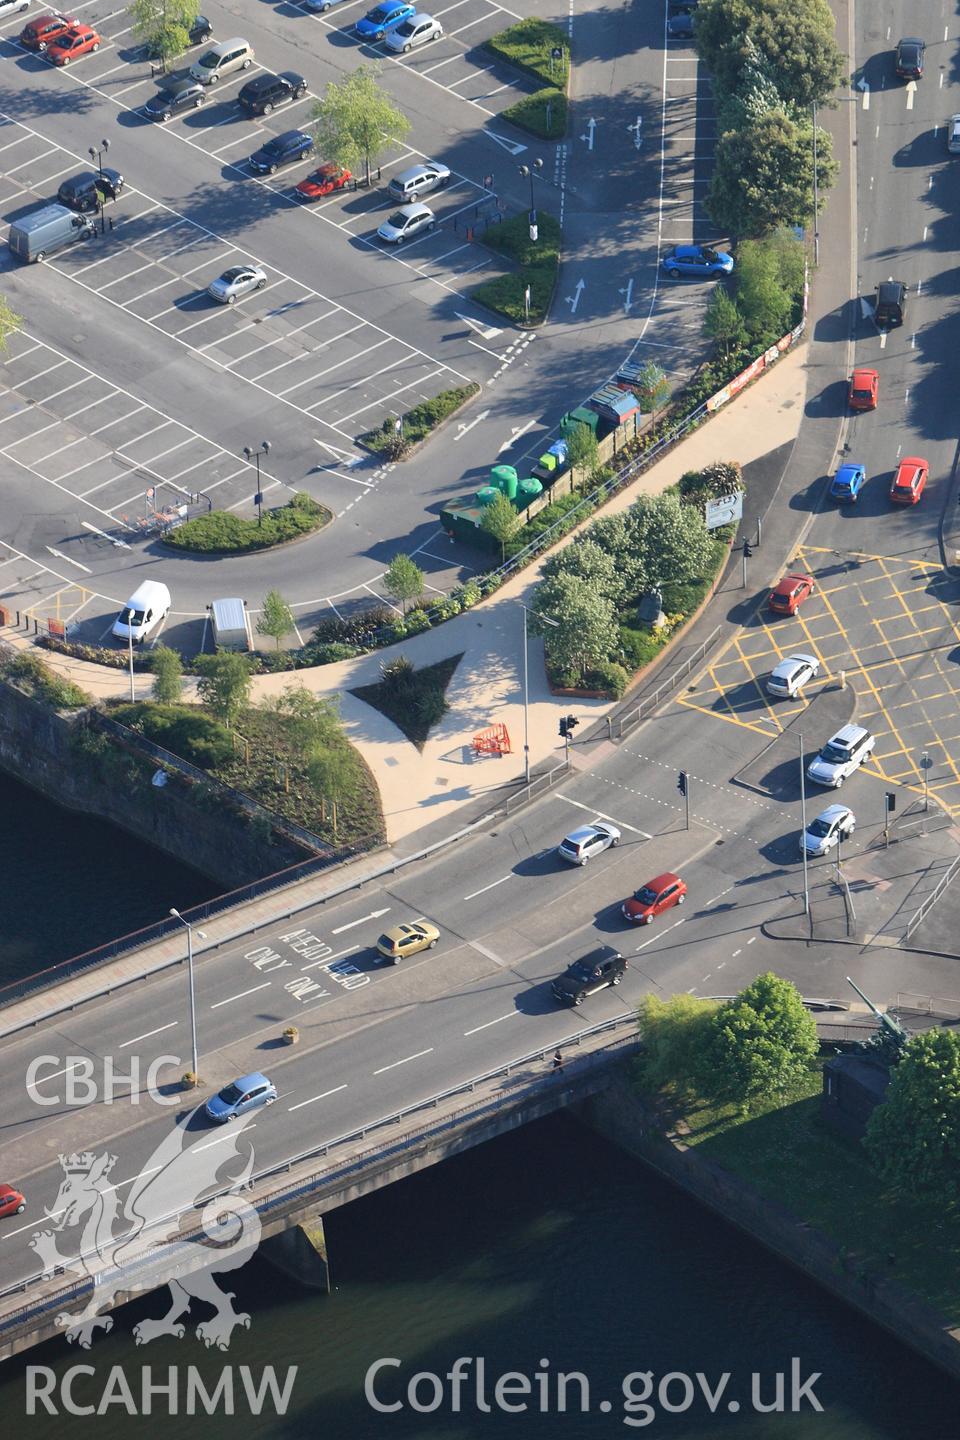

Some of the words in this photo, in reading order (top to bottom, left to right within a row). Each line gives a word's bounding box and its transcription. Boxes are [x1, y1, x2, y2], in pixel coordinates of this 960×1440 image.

[278, 928, 333, 961] AHEAD
[244, 946, 293, 973] ONLY
[284, 976, 331, 1004] ONLY
[318, 962, 371, 990] AHEAD
